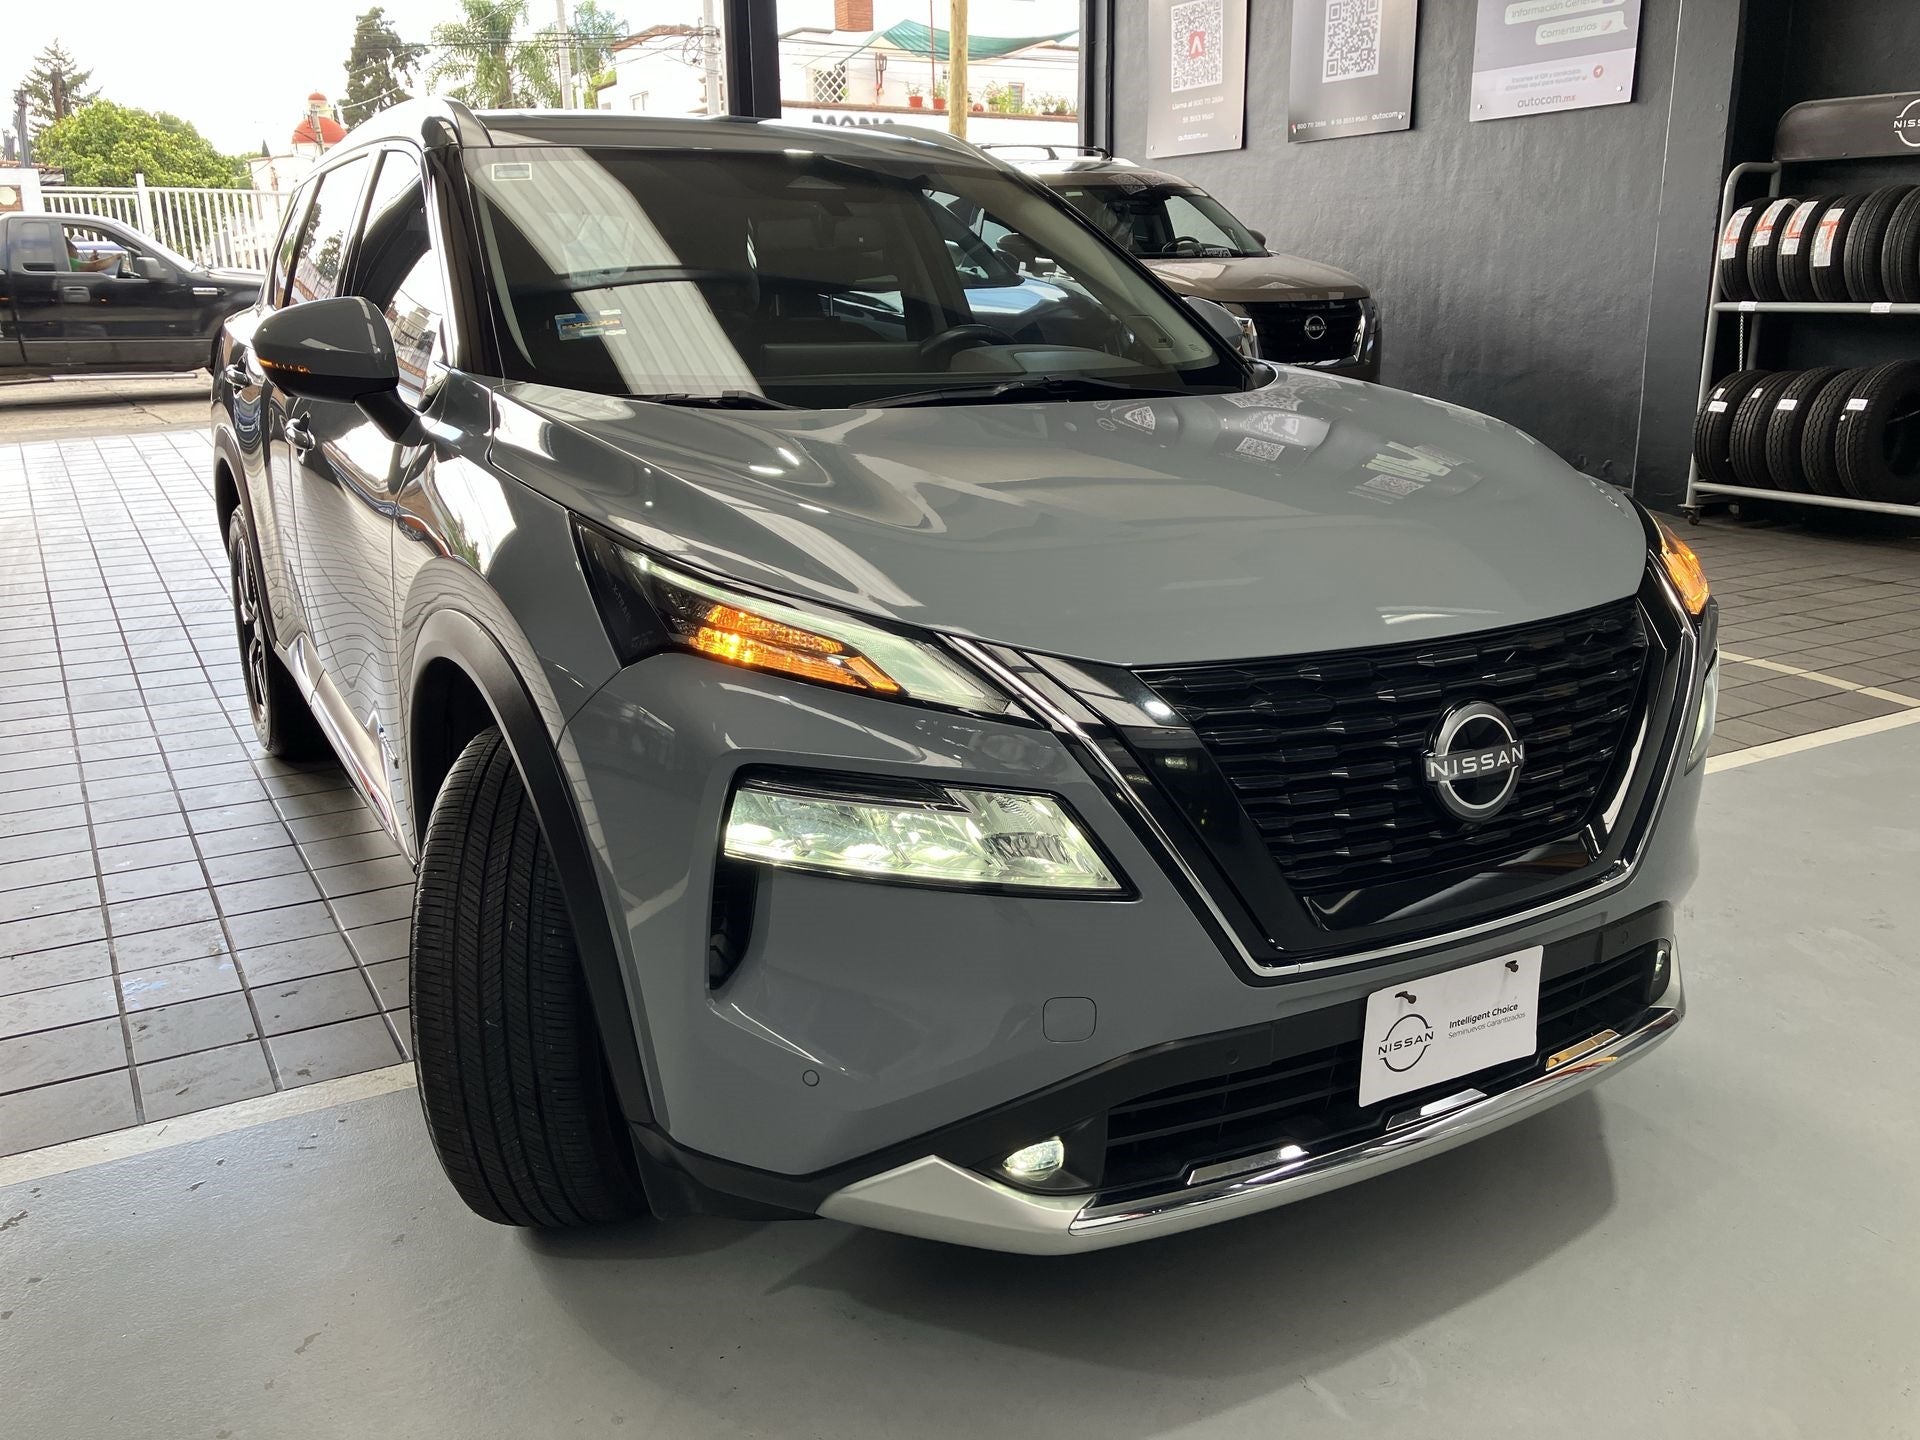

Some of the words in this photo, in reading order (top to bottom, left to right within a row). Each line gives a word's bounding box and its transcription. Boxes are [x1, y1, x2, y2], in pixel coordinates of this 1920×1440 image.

[1541, 23, 1597, 39] Comentarios
[1517, 94, 1576, 108] autocom.mx
[1430, 744, 1524, 778] NISSAN
[1448, 1023, 1486, 1039] Seminuevos
[1486, 1012, 1526, 1028] Garantizados
[1449, 1010, 1490, 1029] Intelligent
[1491, 1003, 1519, 1017] Choice
[1377, 1031, 1434, 1055] NISSAN
